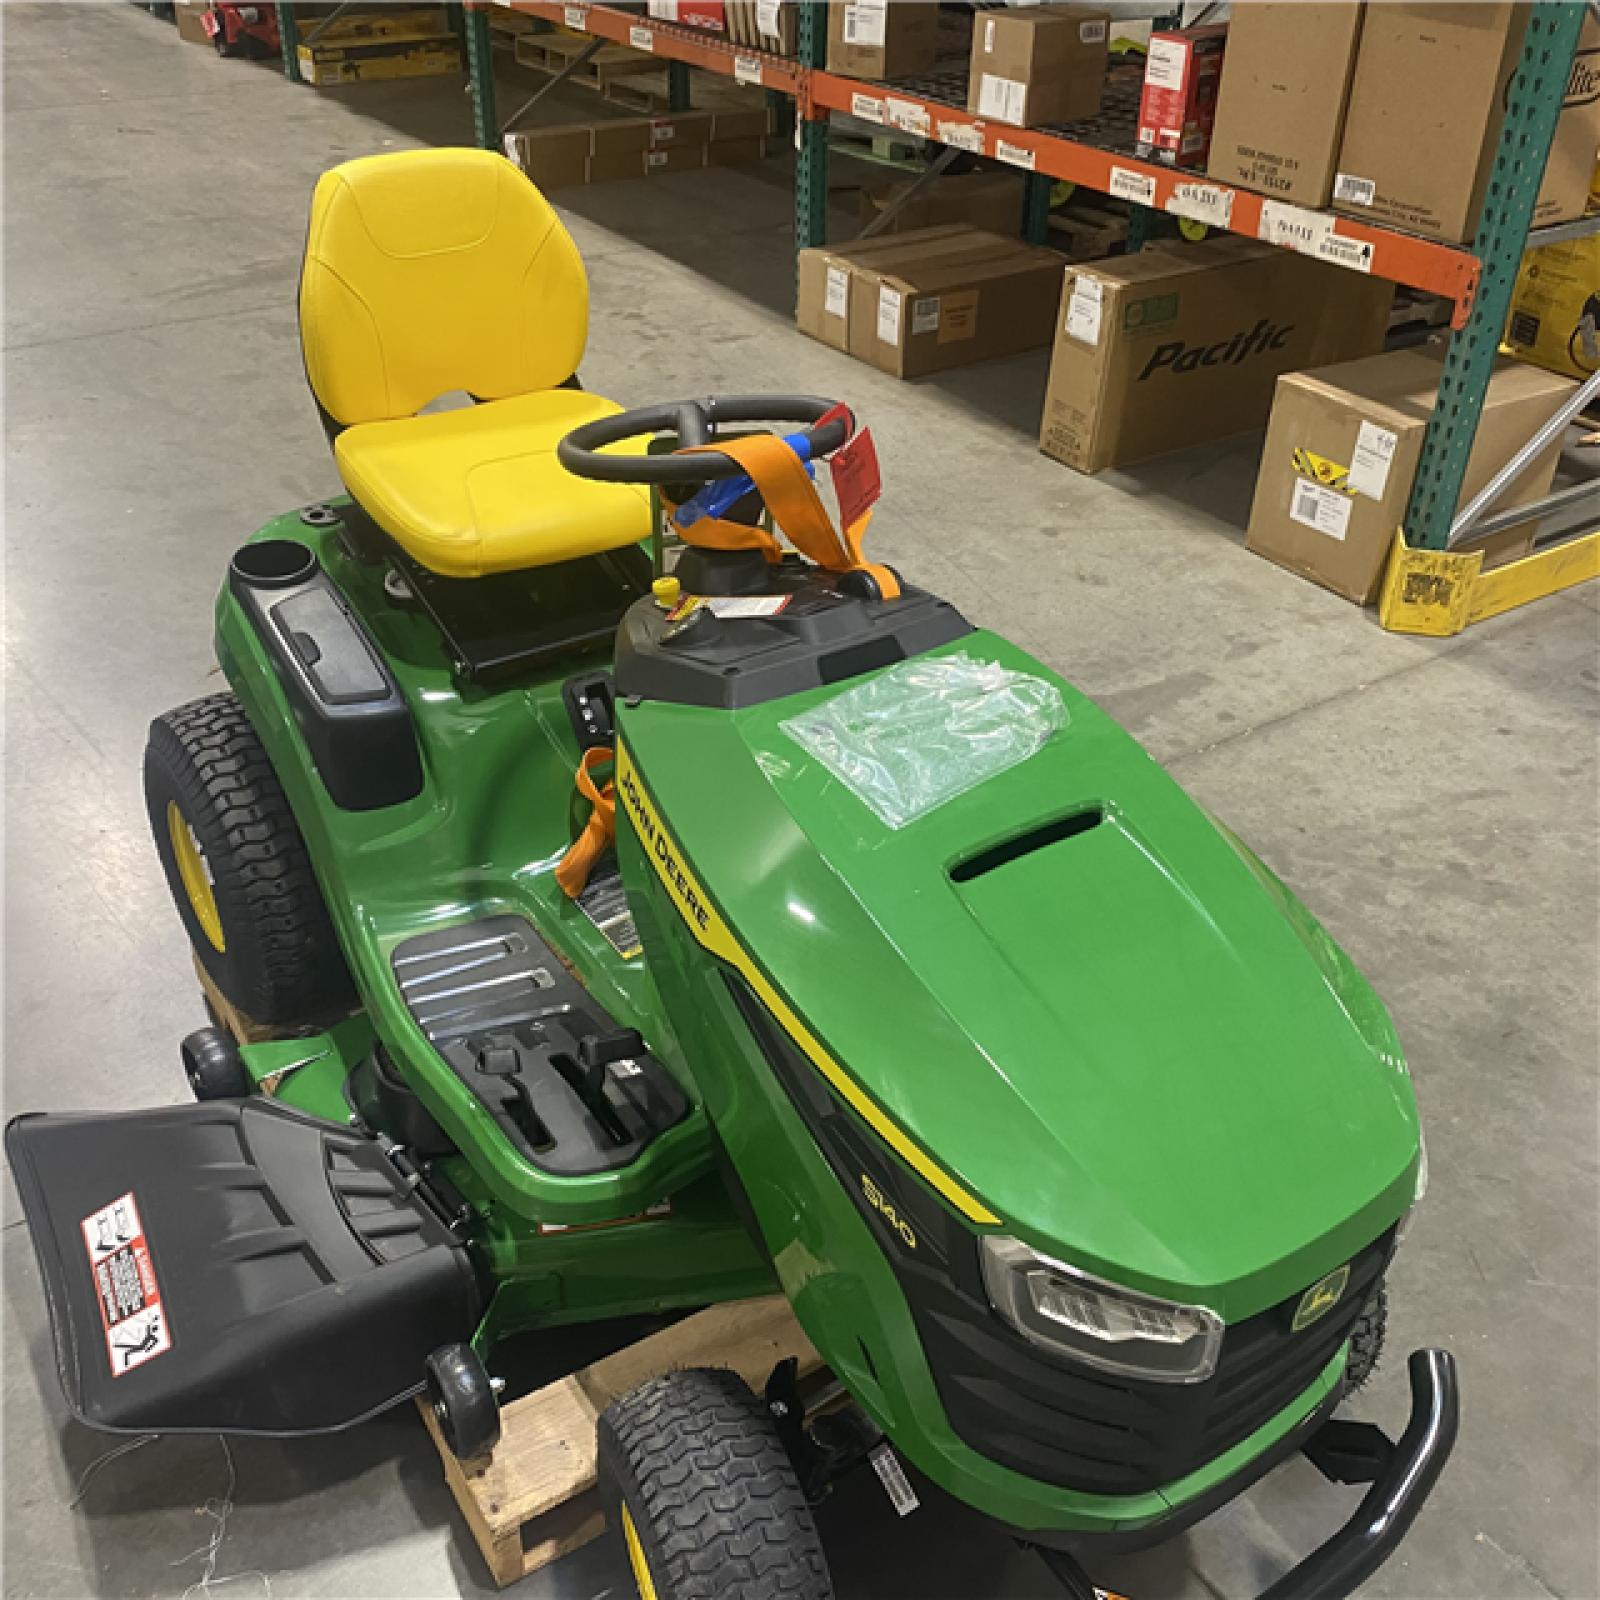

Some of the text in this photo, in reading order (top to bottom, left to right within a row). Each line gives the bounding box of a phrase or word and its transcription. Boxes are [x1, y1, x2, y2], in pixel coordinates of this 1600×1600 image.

[1137, 318, 1296, 382] Pacific
[621, 770, 709, 931] JOHN DEERE
[861, 1174, 916, 1248] S140
